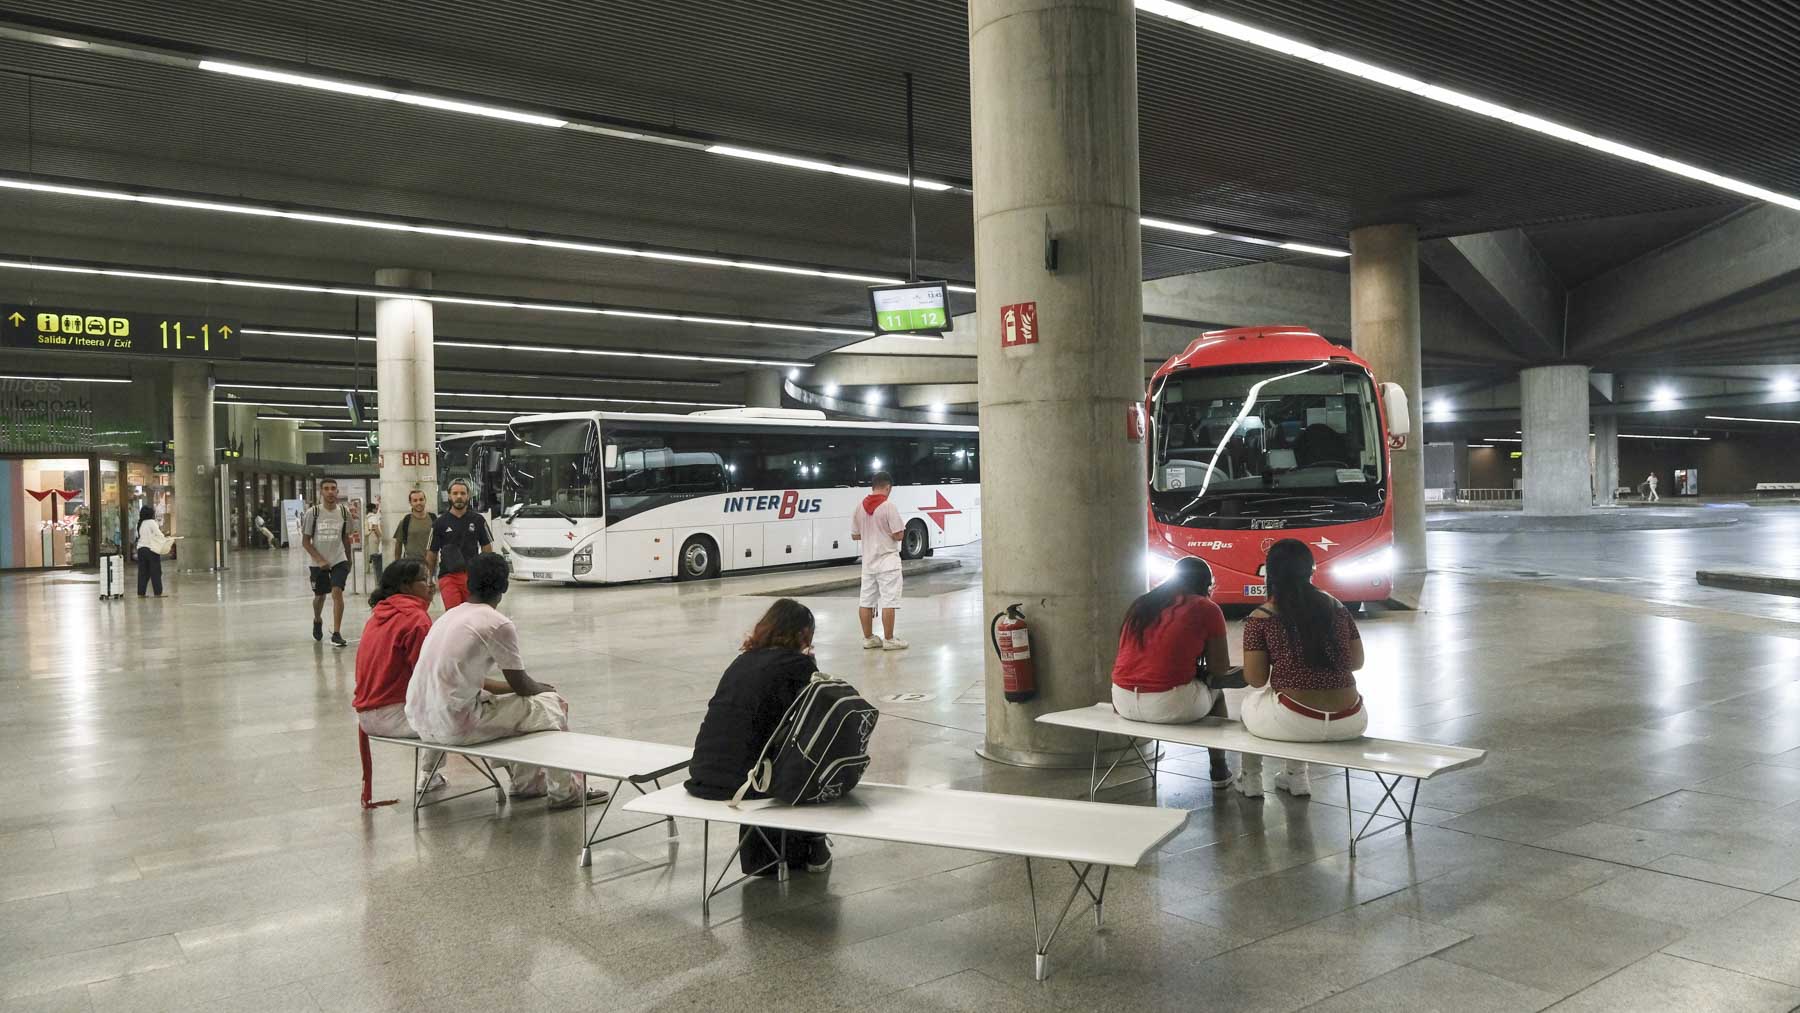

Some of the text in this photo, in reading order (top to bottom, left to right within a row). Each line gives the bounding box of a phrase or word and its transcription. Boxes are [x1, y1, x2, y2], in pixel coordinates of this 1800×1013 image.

[886, 315, 901, 327] 11
[921, 313, 937, 326] 12
[38, 335, 131, 348] Salida / Irteera / Exit
[349, 453, 362, 463] 7-1
[724, 490, 822, 519] INTERBUS
